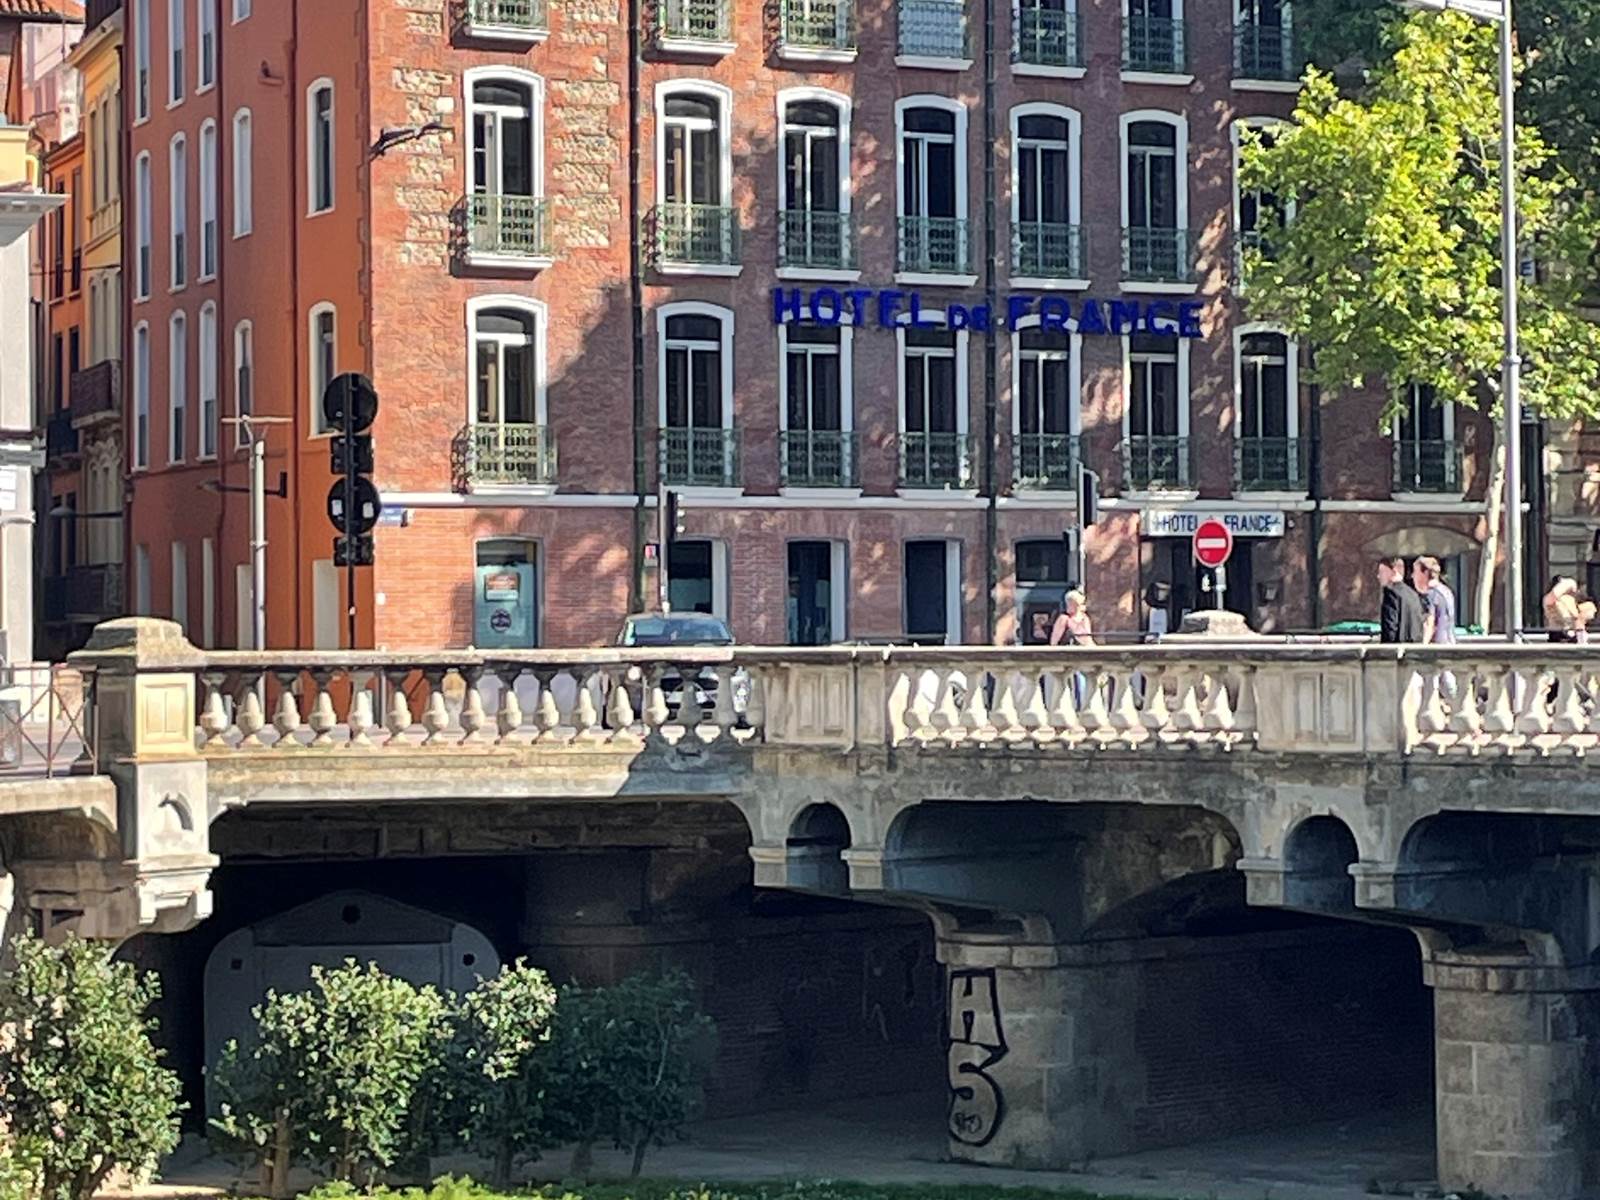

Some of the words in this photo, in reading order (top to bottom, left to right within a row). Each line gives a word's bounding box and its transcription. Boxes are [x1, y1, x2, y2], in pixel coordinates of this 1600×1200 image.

[773, 287, 934, 328] HOTEL
[1008, 295, 1205, 338] FRANCE
[1223, 514, 1272, 533] FRANCE
